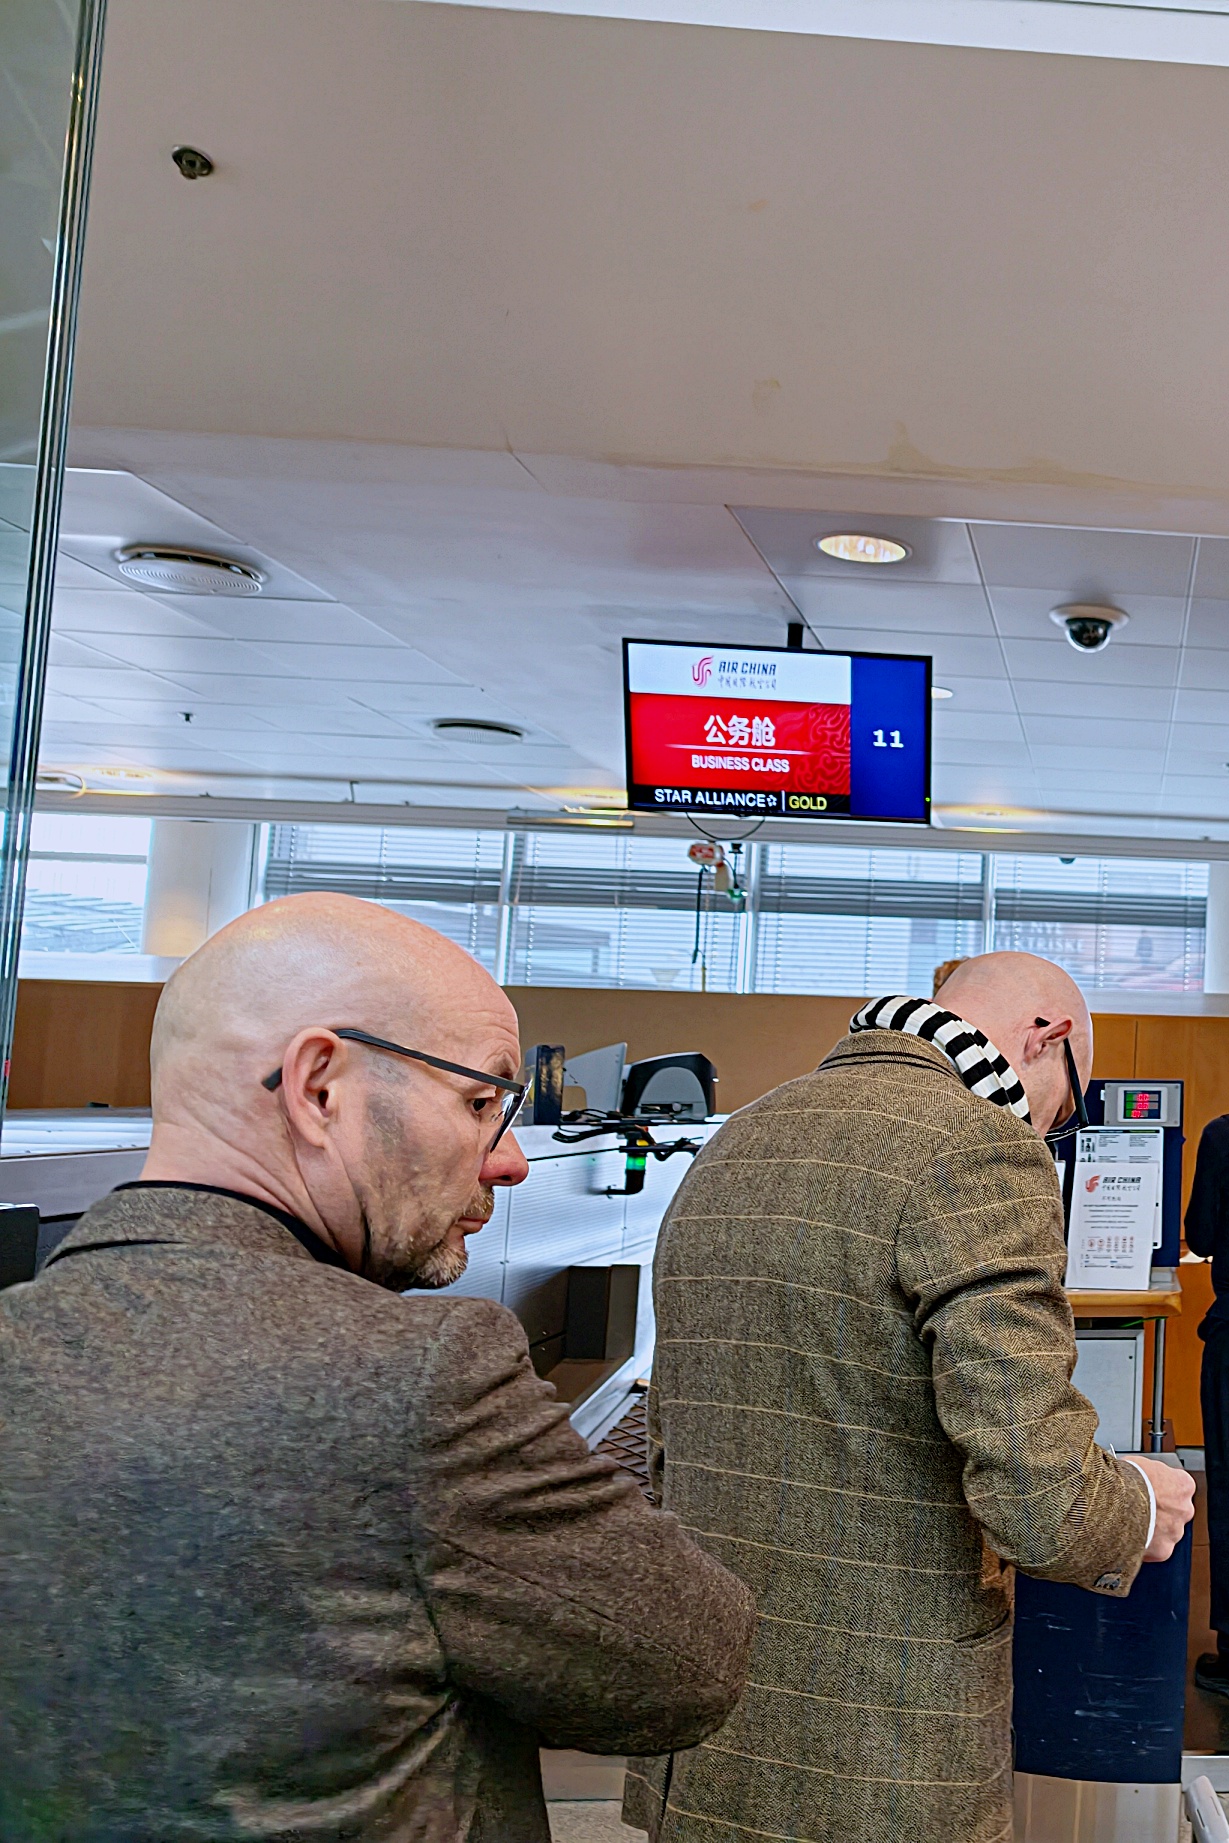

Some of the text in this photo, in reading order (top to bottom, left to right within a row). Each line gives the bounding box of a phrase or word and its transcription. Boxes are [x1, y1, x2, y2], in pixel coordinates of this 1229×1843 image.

[718, 661, 777, 676] AIR CHINA
[703, 714, 776, 747] 公务舱
[872, 728, 904, 749] 11
[691, 753, 790, 773] BUSINESS CLASS
[654, 787, 828, 811] STAR ALLIANCE GOLD
